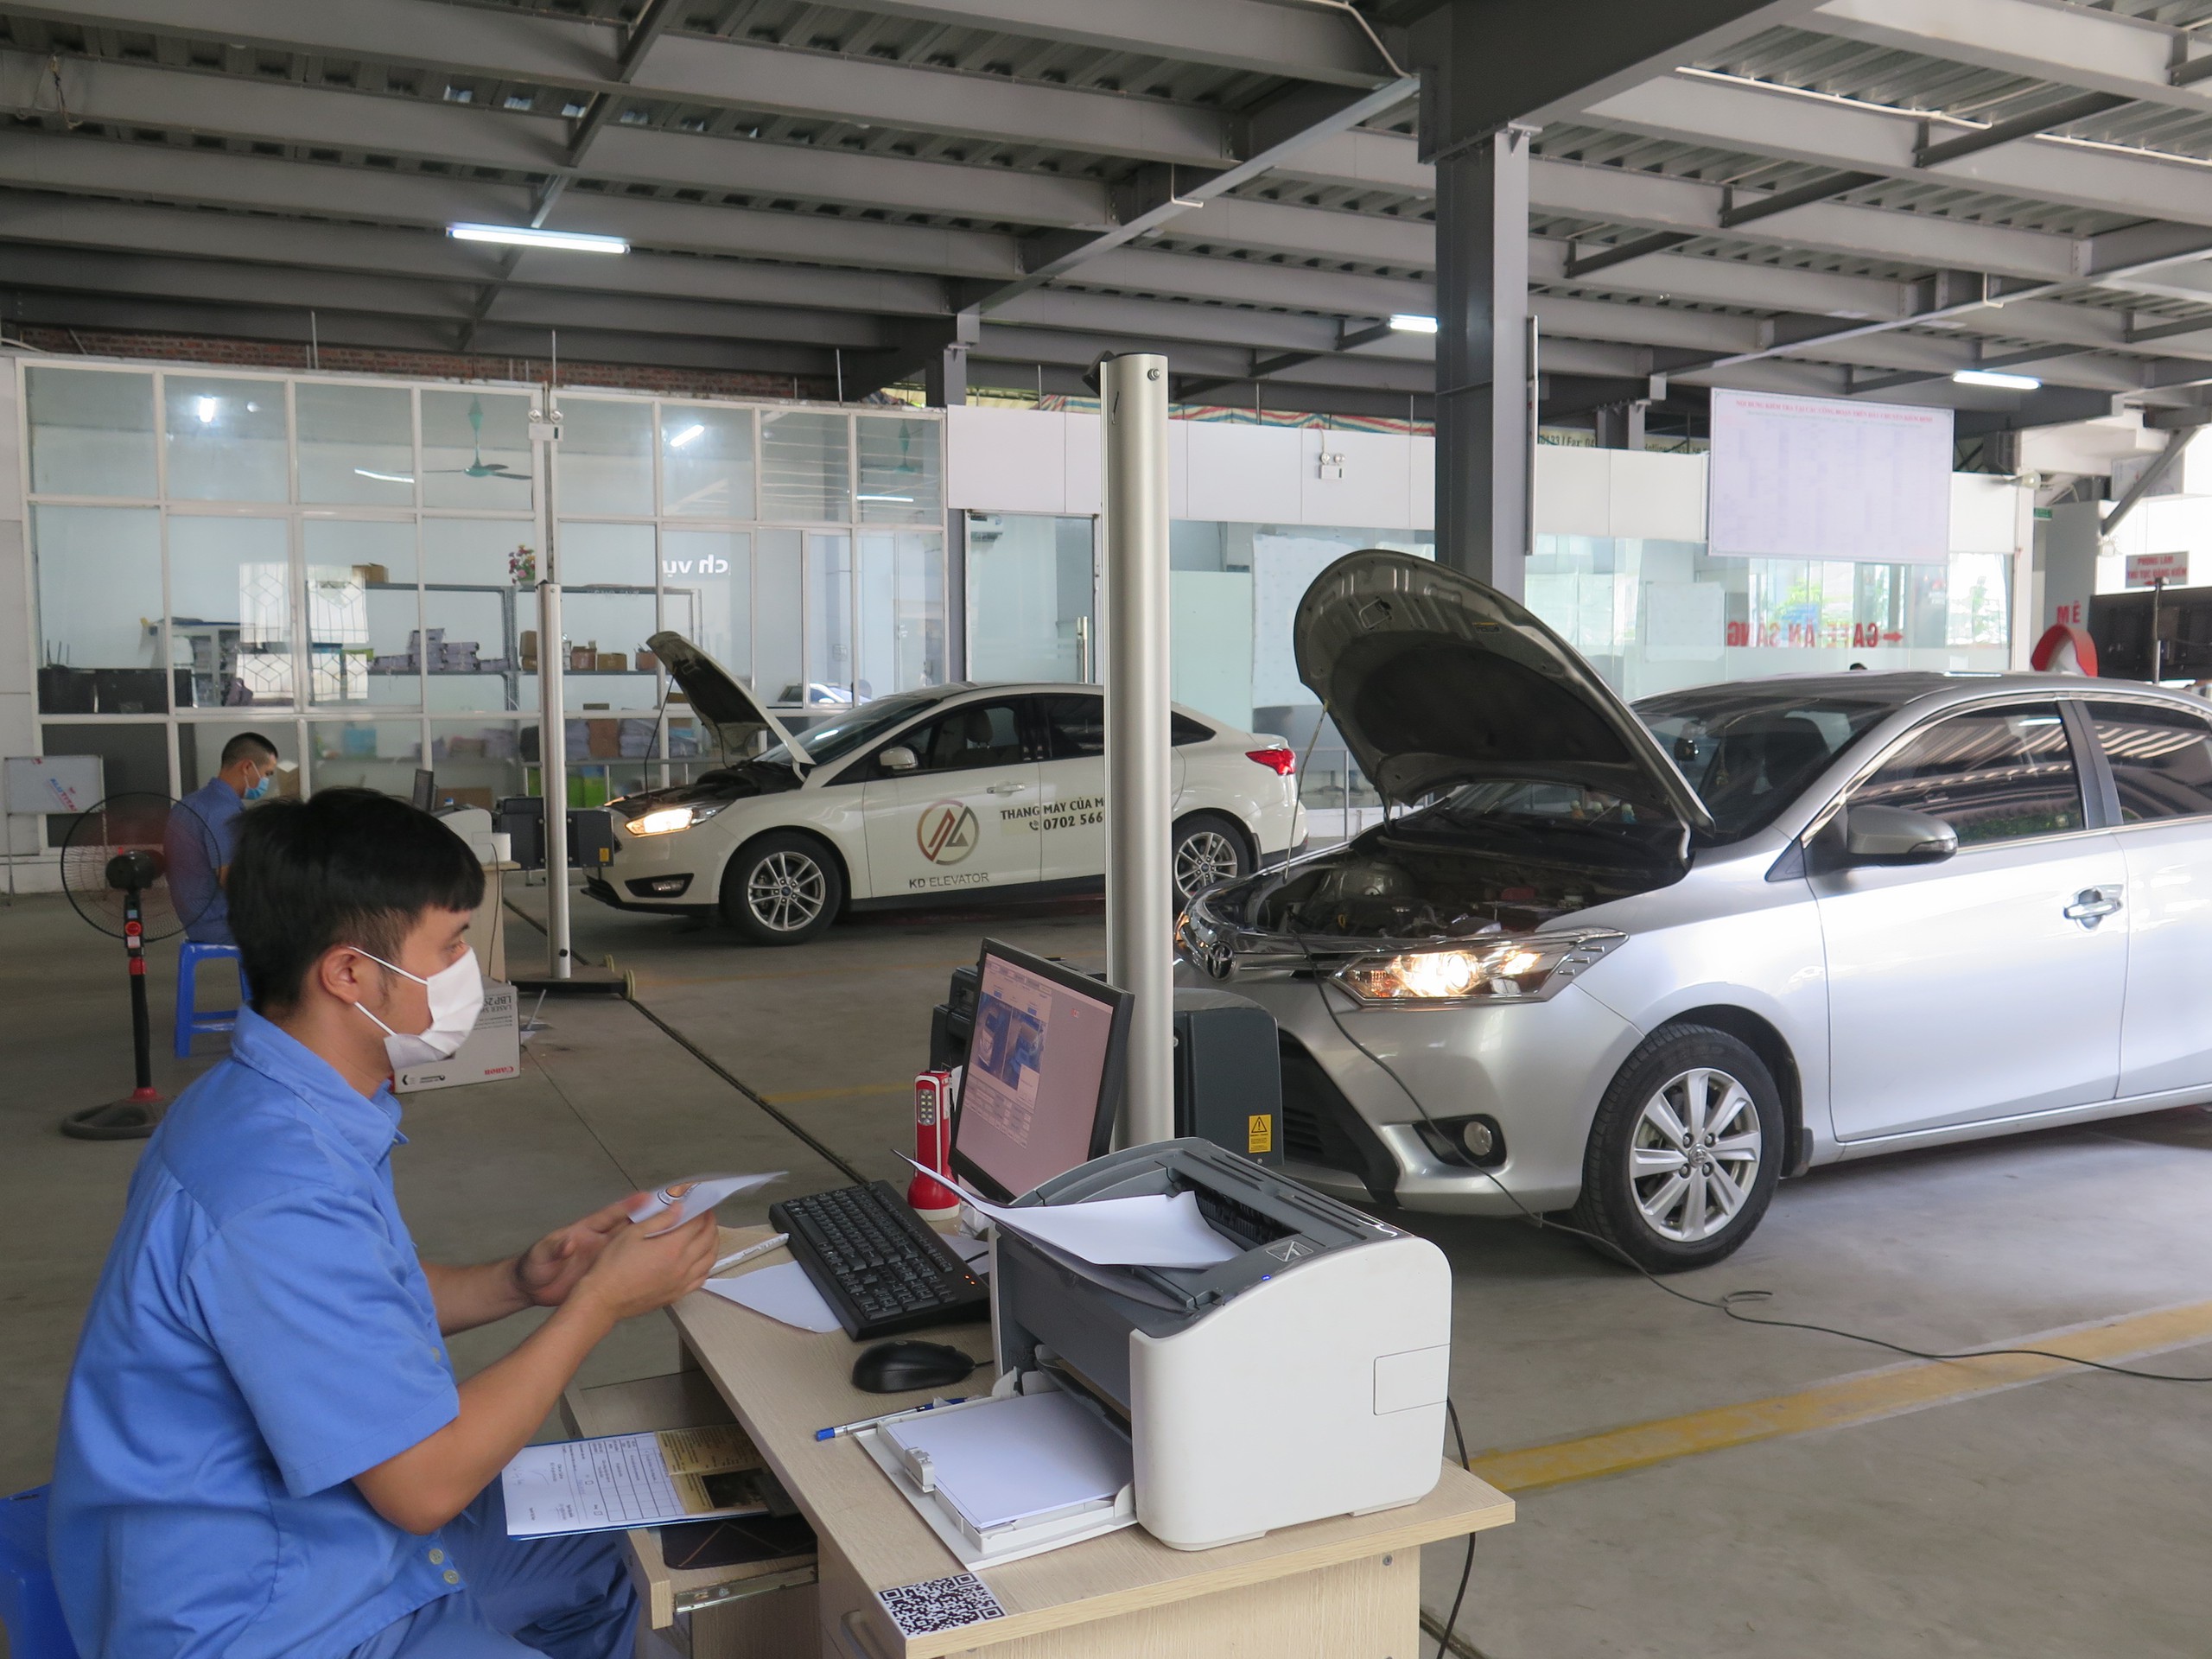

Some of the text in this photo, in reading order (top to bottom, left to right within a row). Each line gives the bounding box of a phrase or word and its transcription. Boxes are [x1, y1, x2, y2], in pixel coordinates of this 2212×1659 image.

[1001, 804, 1040, 821] THANG
[1043, 801, 1067, 815] MÁY
[1070, 797, 1092, 810] CỦA
[1043, 811, 1103, 830] 0702 566
[909, 872, 990, 889] KD ELEVATOR
[484, 1065, 514, 1076] Canon
